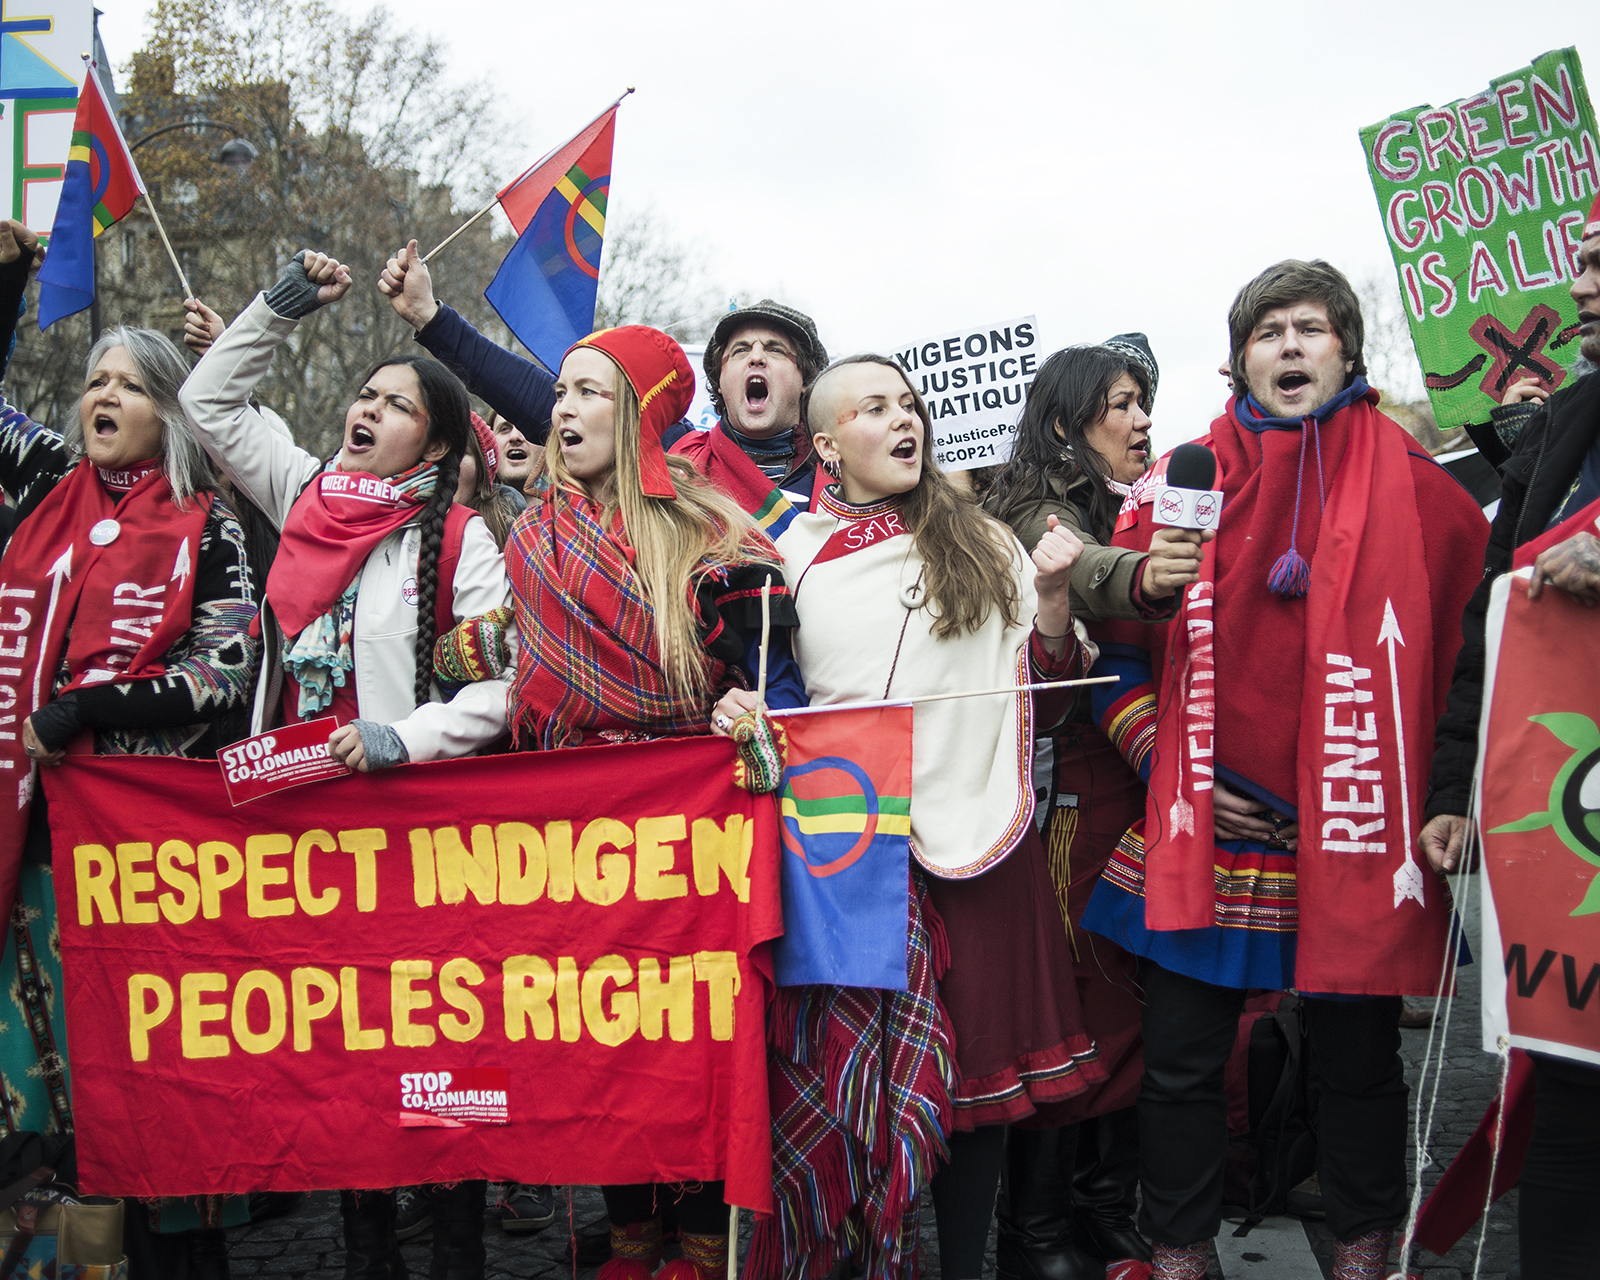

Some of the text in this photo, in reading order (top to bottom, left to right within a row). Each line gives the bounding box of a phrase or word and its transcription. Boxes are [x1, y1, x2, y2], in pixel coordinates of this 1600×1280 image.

[1372, 63, 1581, 183] GREEN
[1387, 129, 1600, 253] GROWTH
[1401, 210, 1586, 322] IS A LIE
[888, 322, 1035, 373] XIGEONS
[917, 353, 1038, 397] JUSTICE
[927, 381, 1034, 421] MATIQU
[936, 443, 996, 464] #COP21
[357, 477, 402, 502] RENEW
[222, 736, 276, 770] STOP
[1321, 653, 1387, 853] RENEW
[73, 828, 388, 926] RESPECT
[127, 950, 742, 1062] PEOPLES RIGHT
[400, 1071, 452, 1094] STOP
